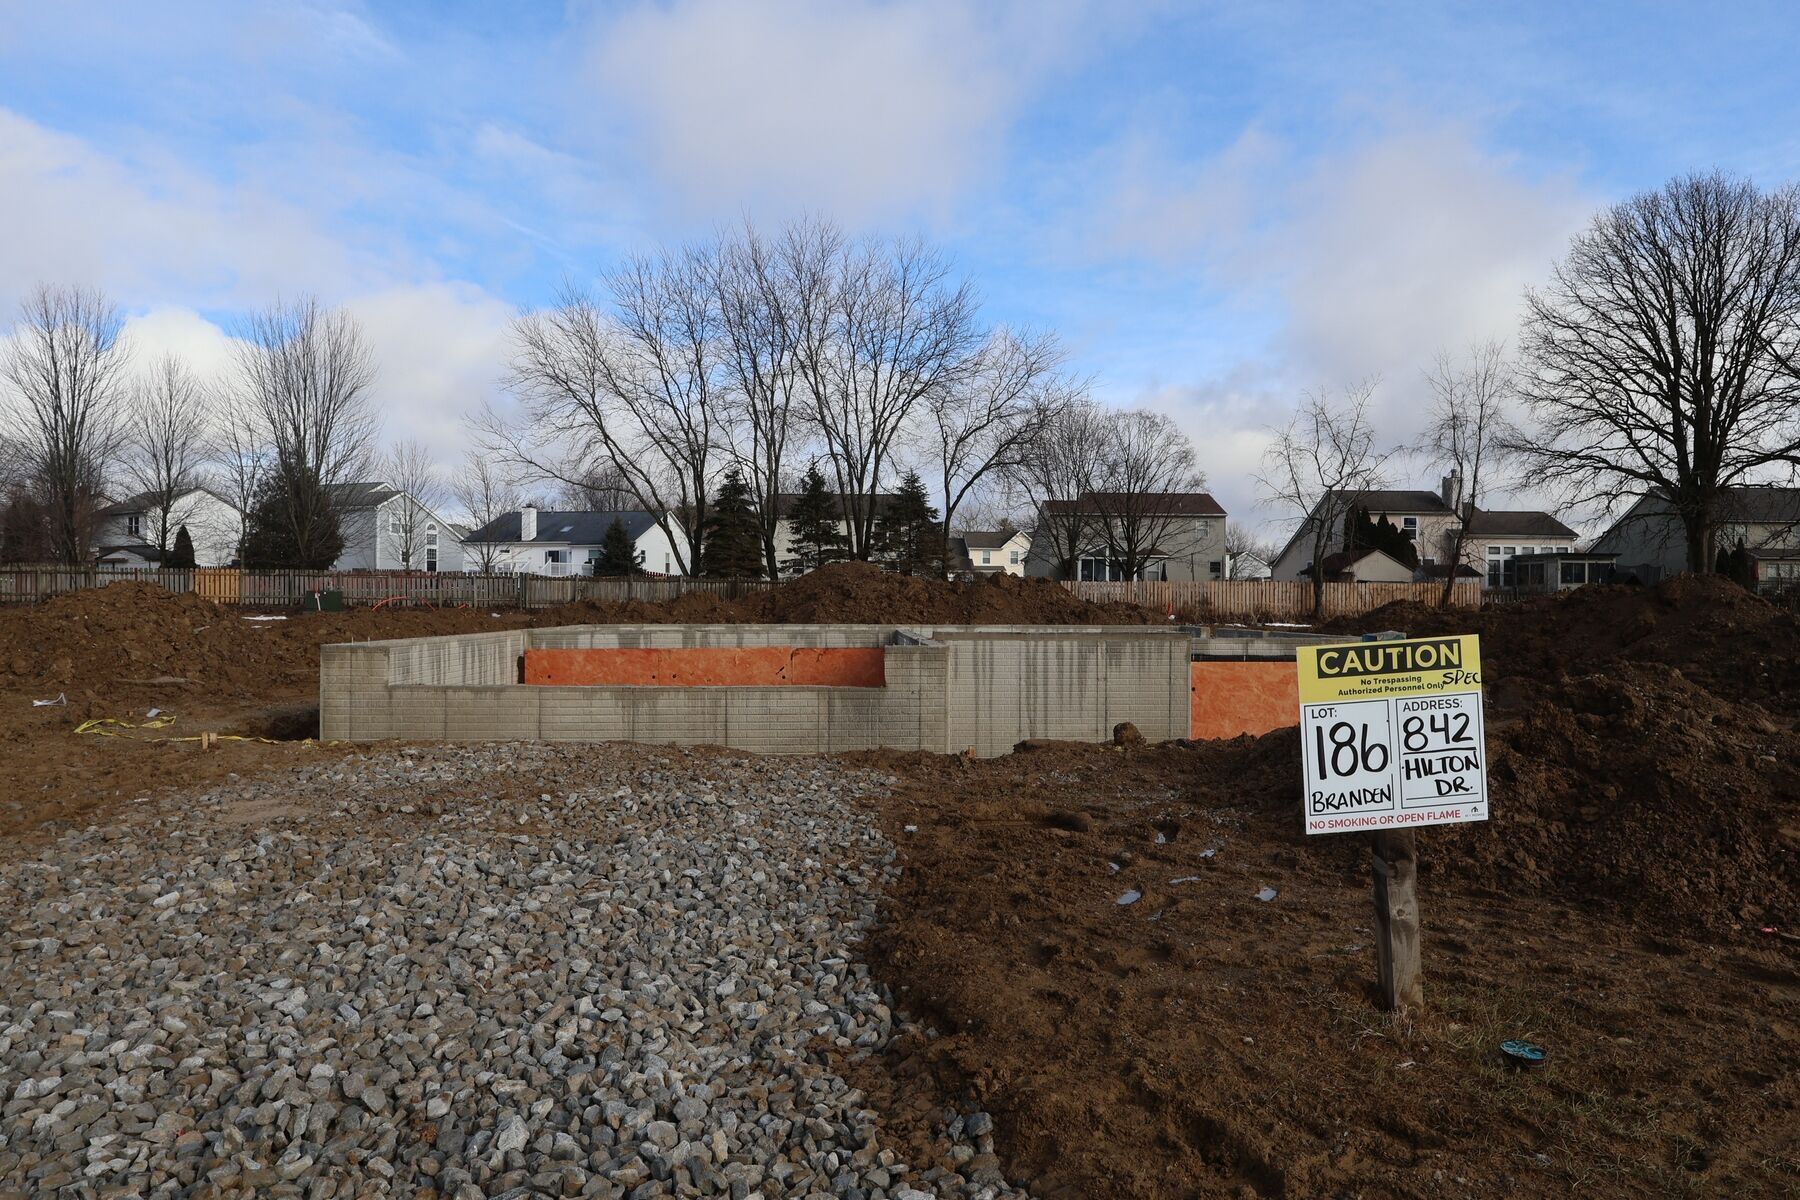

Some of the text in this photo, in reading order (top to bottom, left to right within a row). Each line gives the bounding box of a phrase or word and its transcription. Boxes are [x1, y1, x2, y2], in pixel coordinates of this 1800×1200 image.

[1319, 642, 1460, 675] CAUTION
[1338, 681, 1445, 696] Authorized Personnel Only
[1373, 675, 1422, 685] Trespassing
[1311, 707, 1338, 719] LOT:
[1402, 698, 1463, 713] ADDRESS:
[1402, 712, 1474, 752] 842
[1315, 721, 1389, 781] 186
[1403, 750, 1480, 781] HILTON
[1434, 776, 1473, 796] DR.
[1311, 783, 1392, 813] BRANDEN
[1309, 820, 1326, 830] NO
[1328, 816, 1377, 829] SMOKING
[1379, 815, 1395, 825] OR
[1396, 813, 1425, 824] OPEN
[1427, 809, 1461, 821] FLAME
